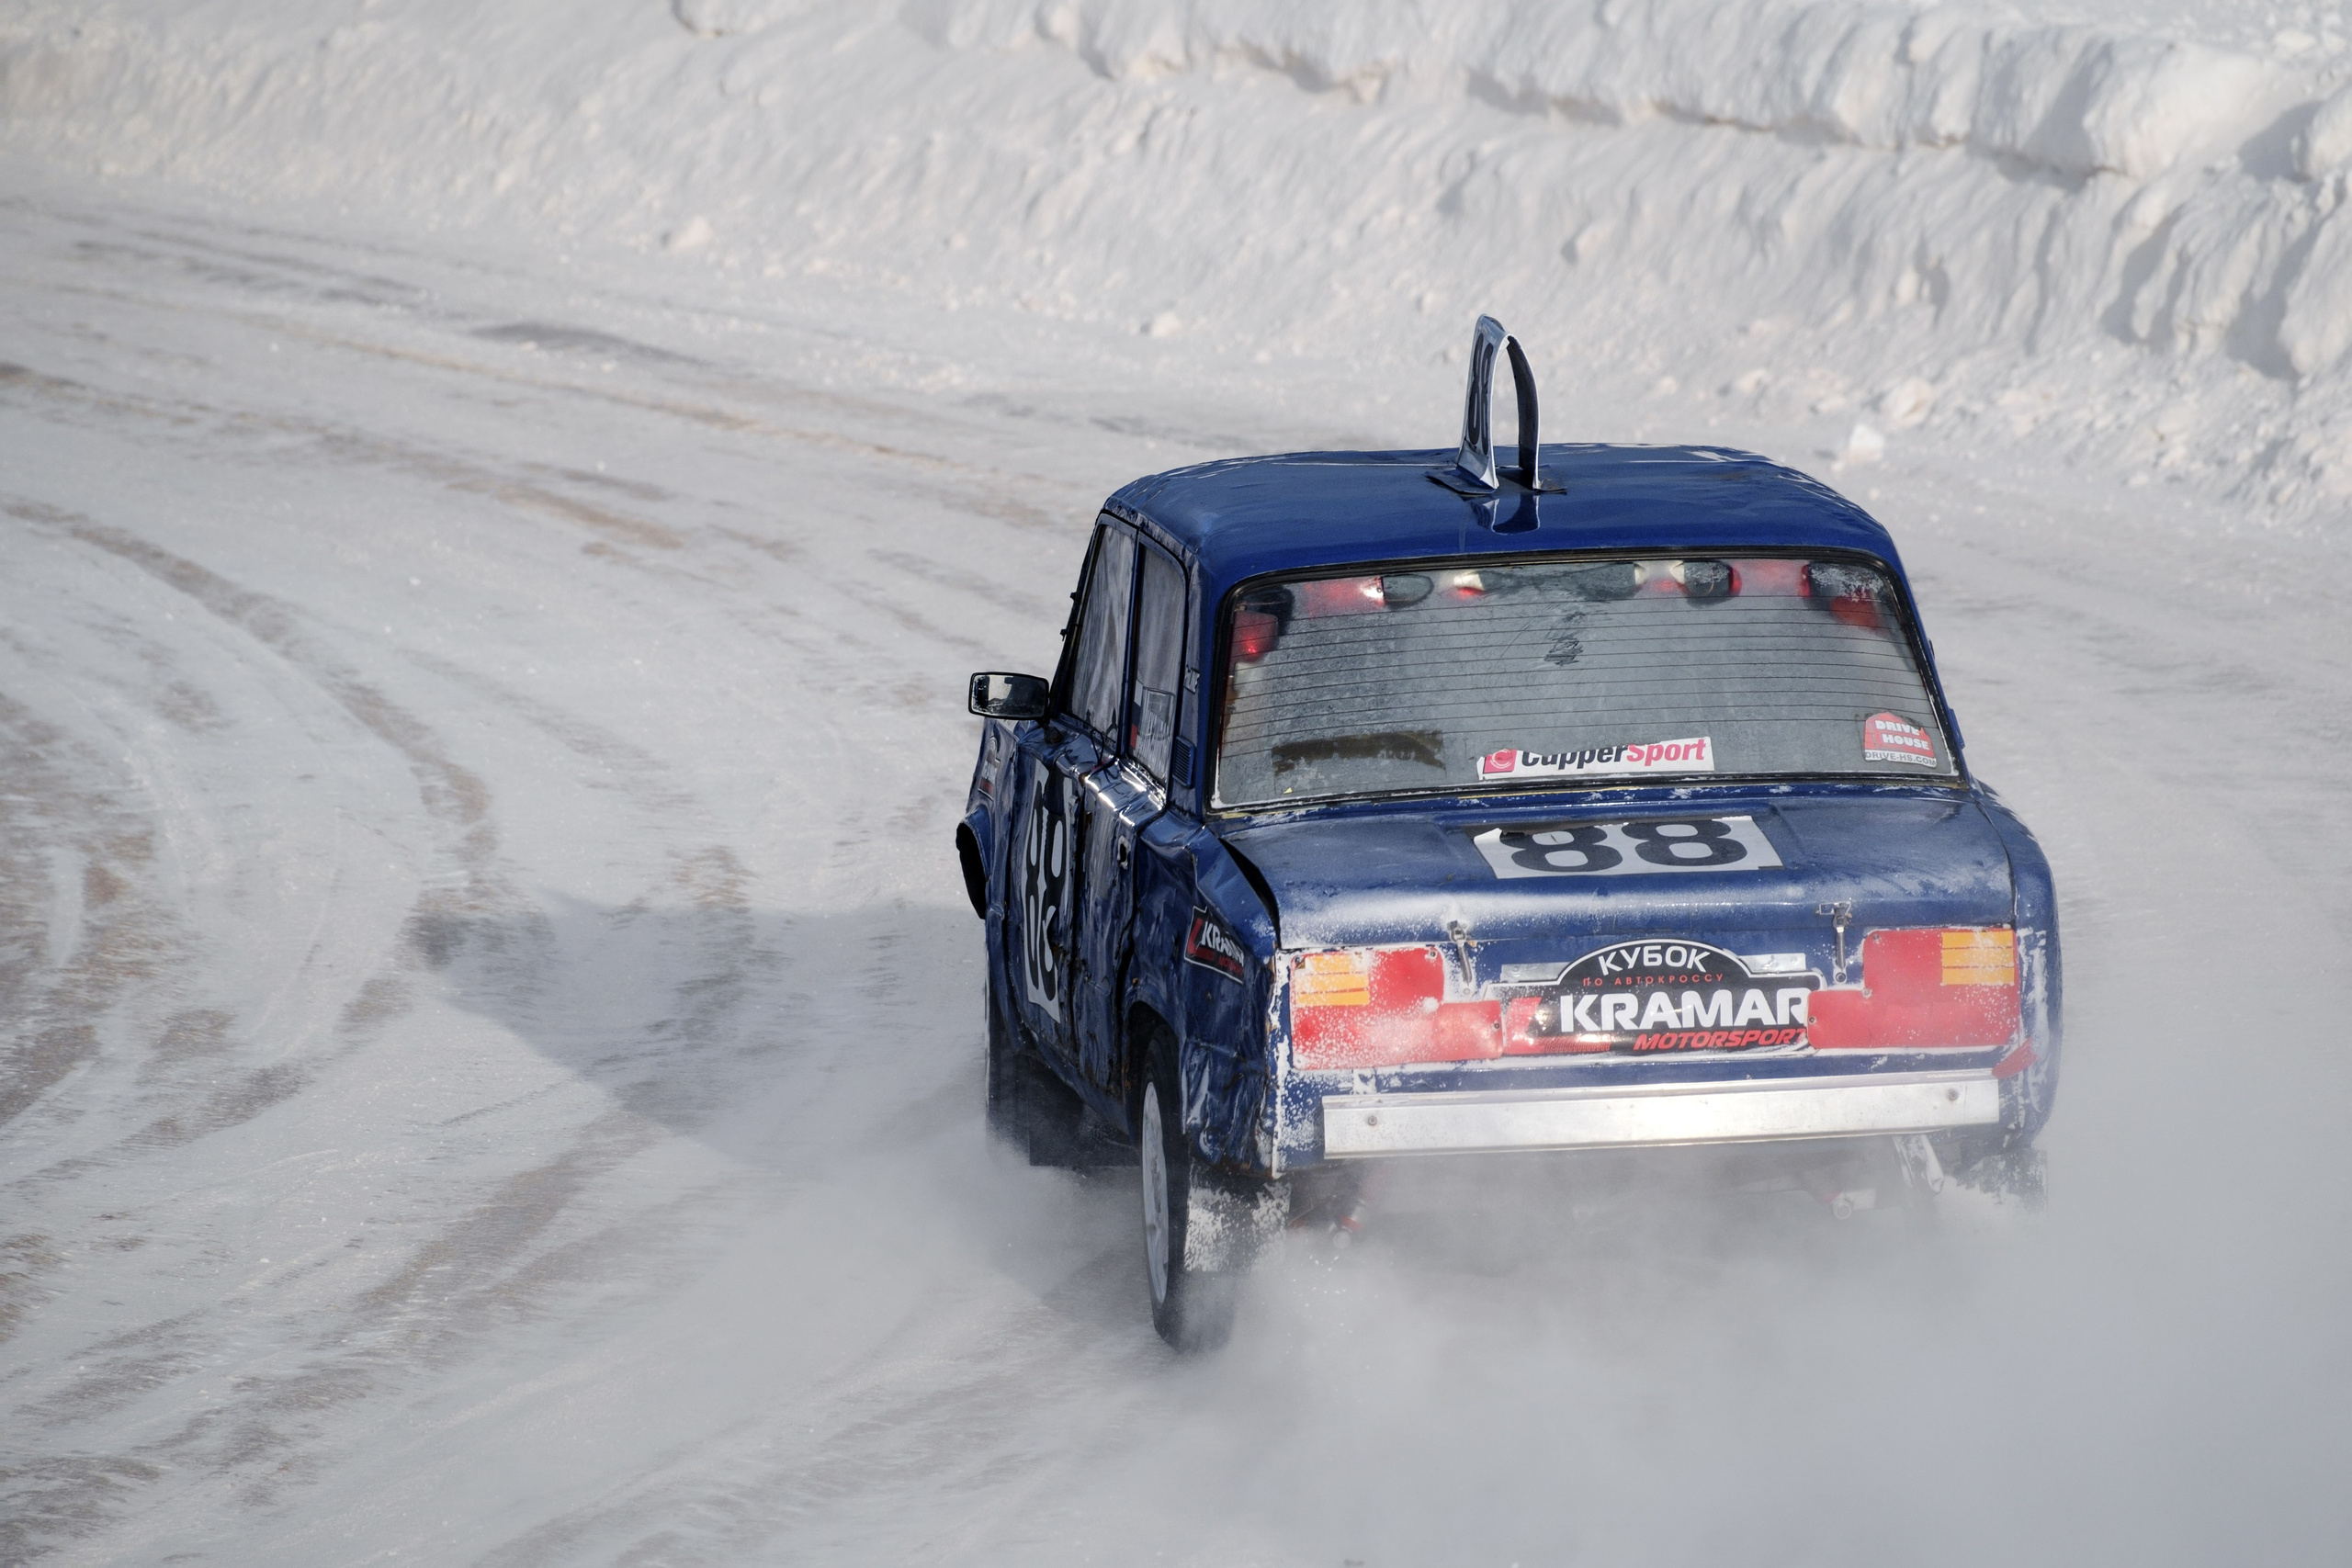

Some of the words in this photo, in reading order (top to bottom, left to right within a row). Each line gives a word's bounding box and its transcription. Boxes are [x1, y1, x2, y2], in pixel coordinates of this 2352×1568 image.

[1875, 719, 1920, 736] DRIVE
[1882, 733, 1930, 750] HOUSE
[1865, 750, 1936, 766] DRIVE-HS.COM
[1499, 820, 1748, 873] 88
[1598, 944, 1711, 976] КУБОК
[1583, 977, 1603, 987] ПО
[1614, 974, 1724, 986] АВТОКРОССУ
[1561, 987, 1812, 1032] KRAMAR
[1633, 1028, 1807, 1051] MOTORSPORT
